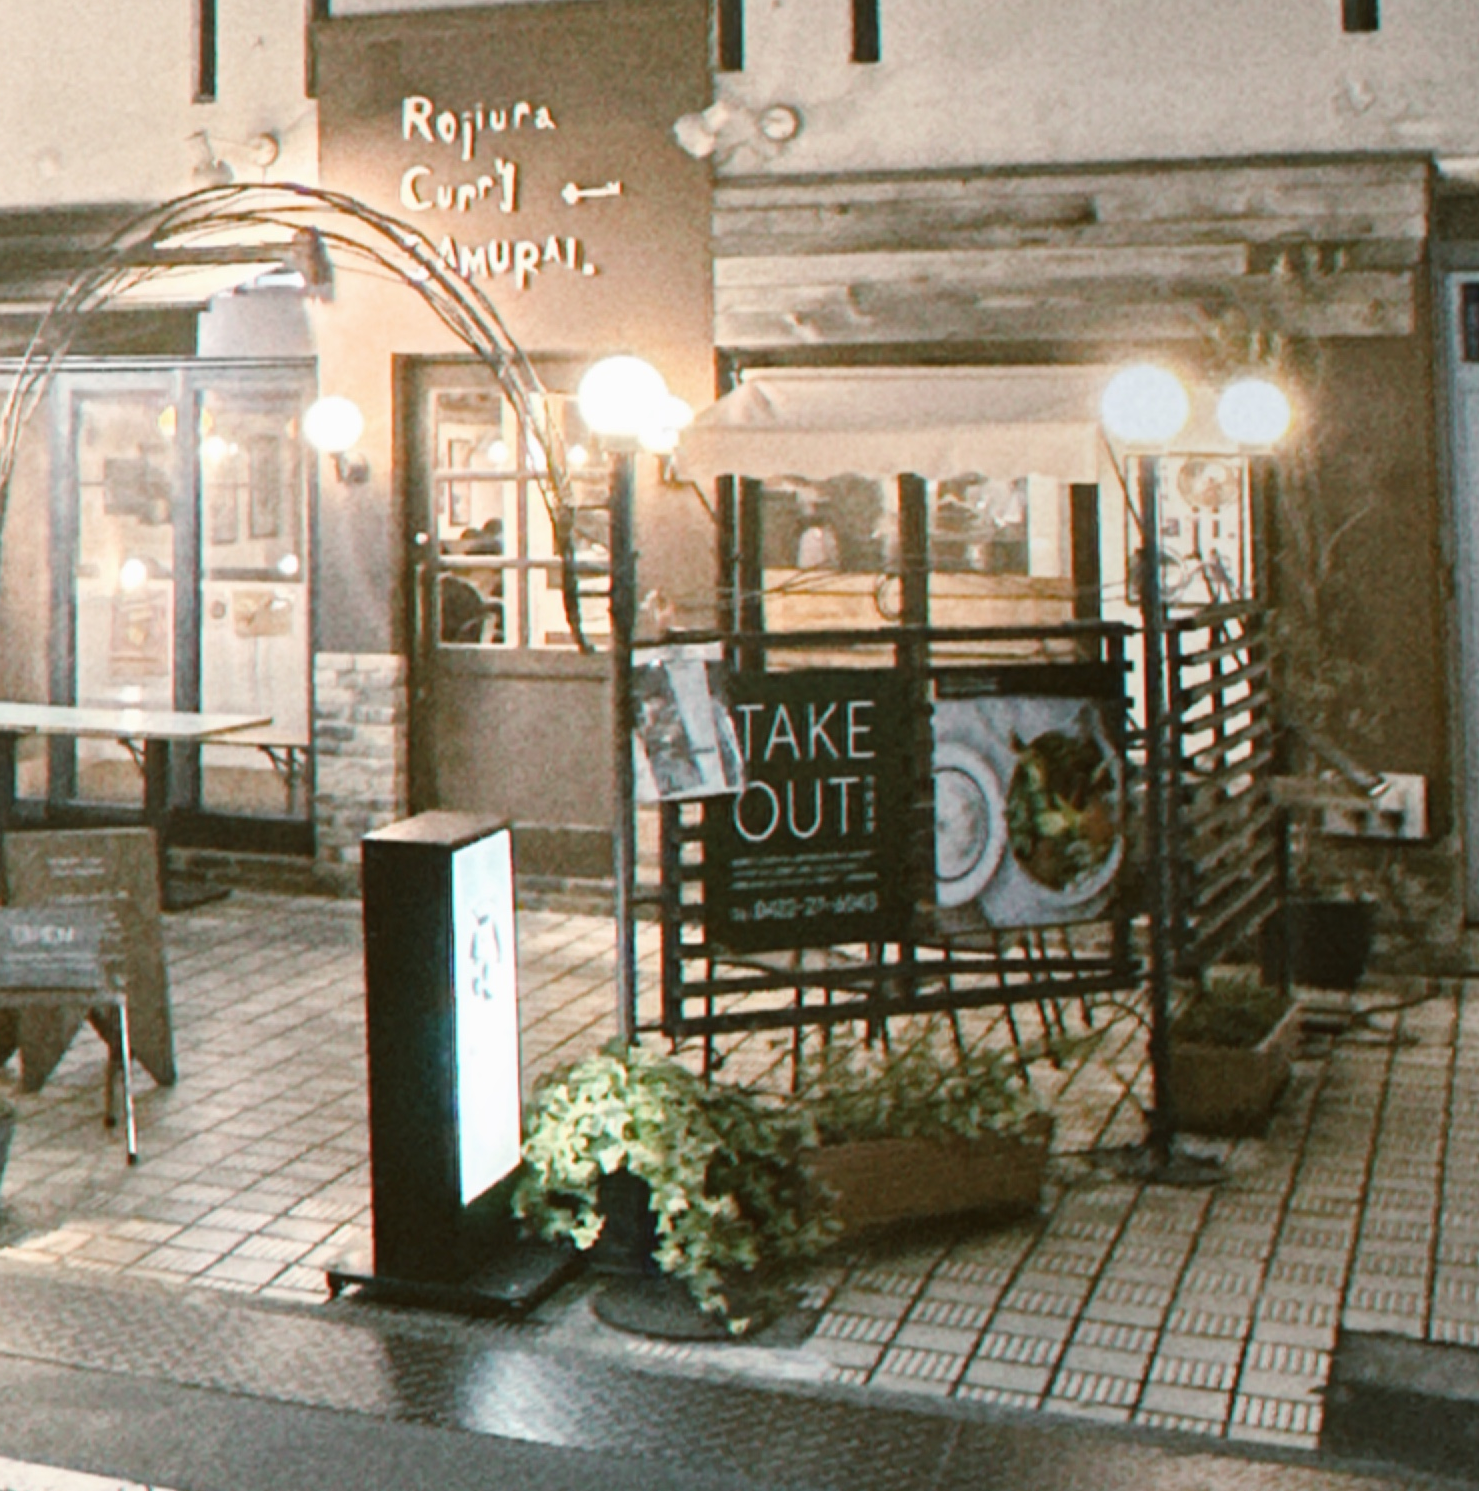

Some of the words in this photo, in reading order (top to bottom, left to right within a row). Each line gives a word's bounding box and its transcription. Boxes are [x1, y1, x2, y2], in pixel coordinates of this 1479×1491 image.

[402, 95, 556, 162] Rojiura
[400, 158, 518, 213] Curry
[735, 699, 876, 762] TAKE
[733, 776, 861, 843] OUT
